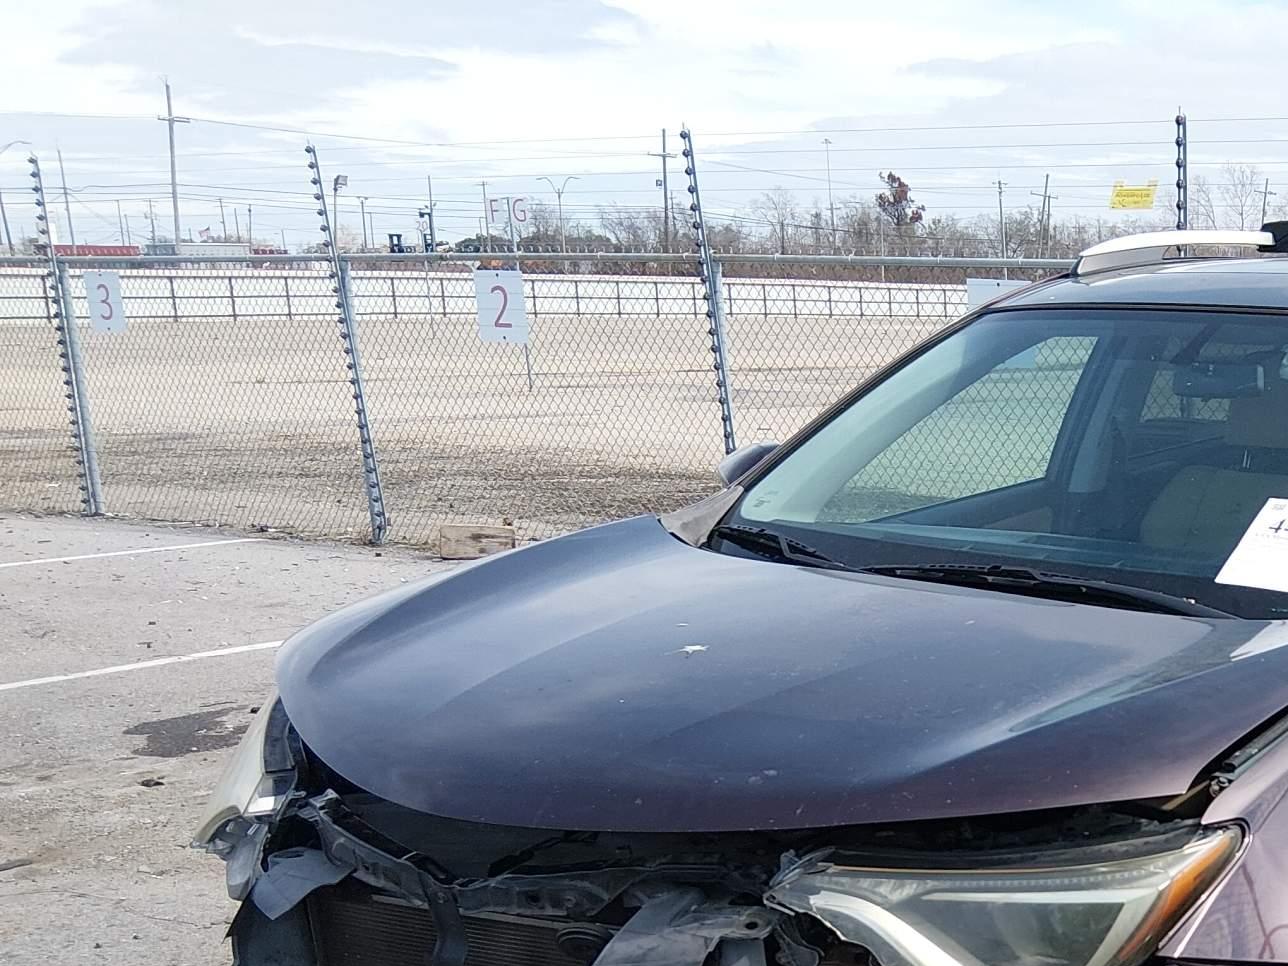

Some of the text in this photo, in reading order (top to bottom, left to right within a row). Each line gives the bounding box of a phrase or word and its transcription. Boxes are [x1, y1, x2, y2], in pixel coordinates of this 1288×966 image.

[489, 199, 499, 223] F
[512, 198, 527, 223] G
[97, 284, 113, 320] 3
[490, 285, 513, 328] 2
